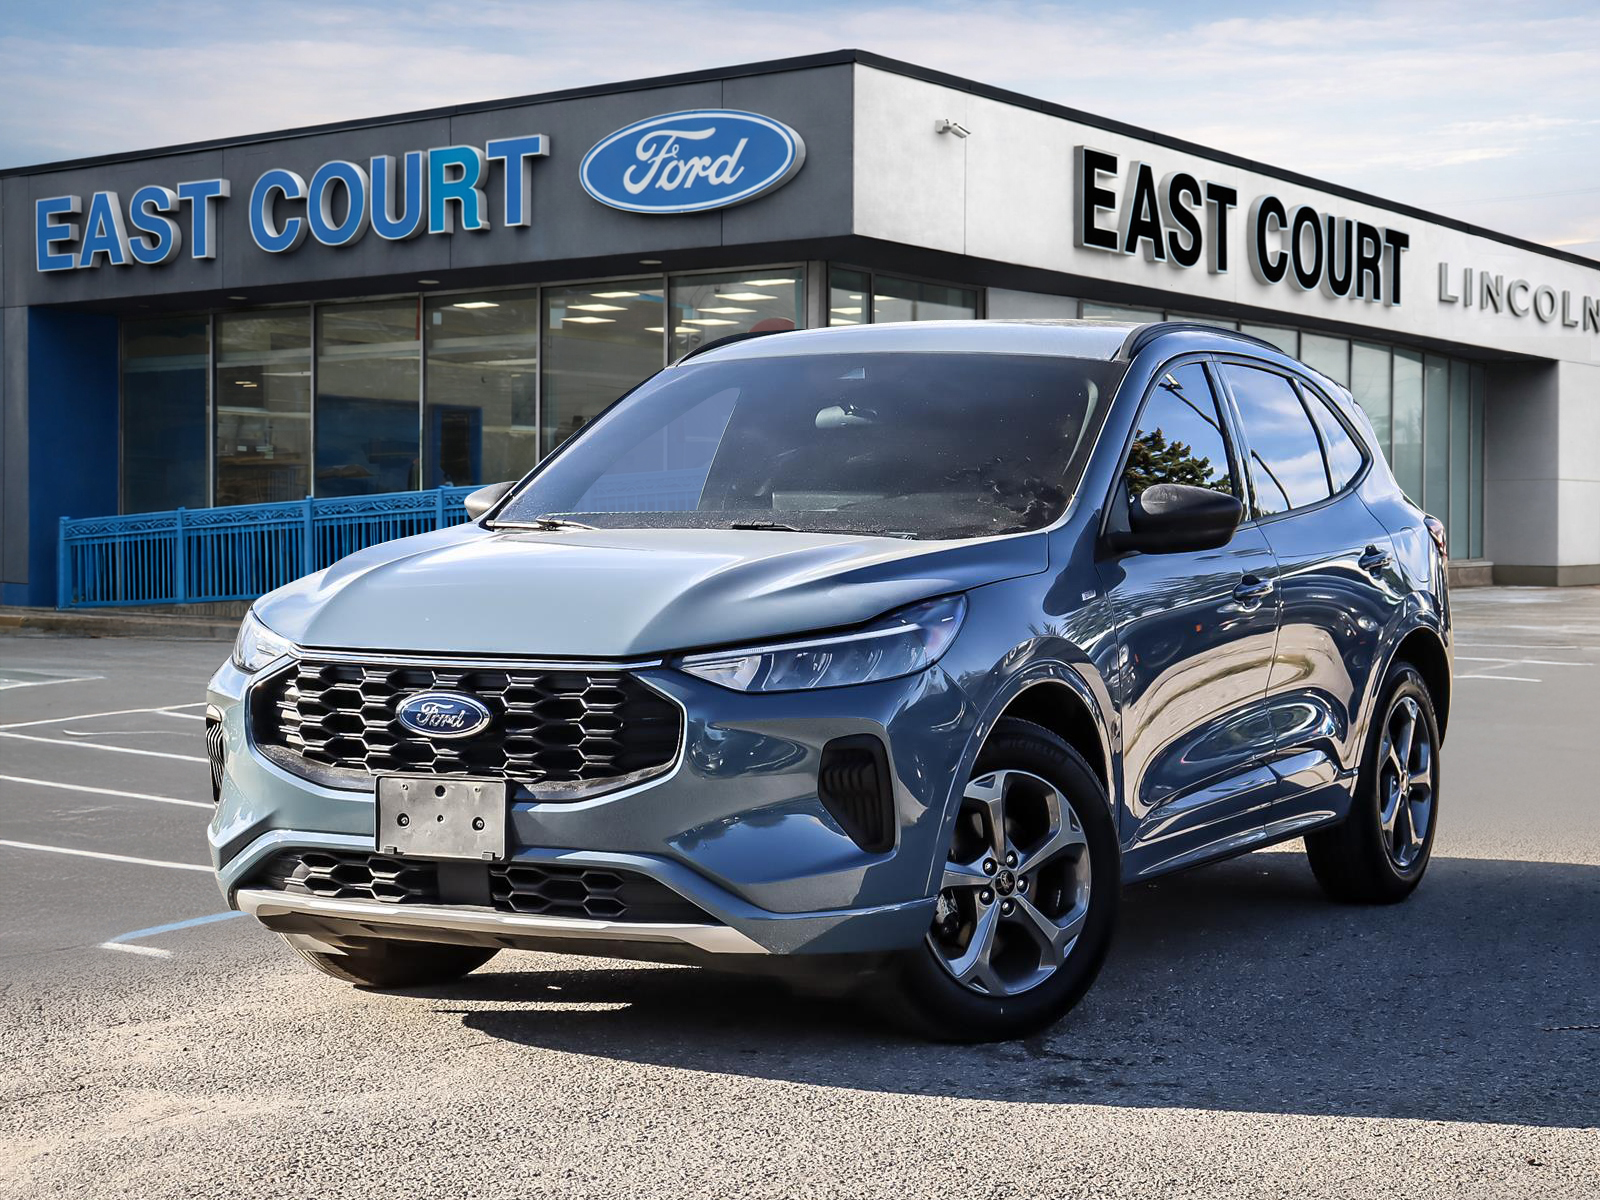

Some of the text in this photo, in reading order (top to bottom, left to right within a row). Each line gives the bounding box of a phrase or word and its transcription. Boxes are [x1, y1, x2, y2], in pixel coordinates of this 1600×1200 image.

[35, 134, 550, 272] EAST COURT
[622, 126, 749, 195] Ford
[1073, 145, 1600, 334] EAST COURT LINCOLN
[416, 701, 465, 728] Ford
